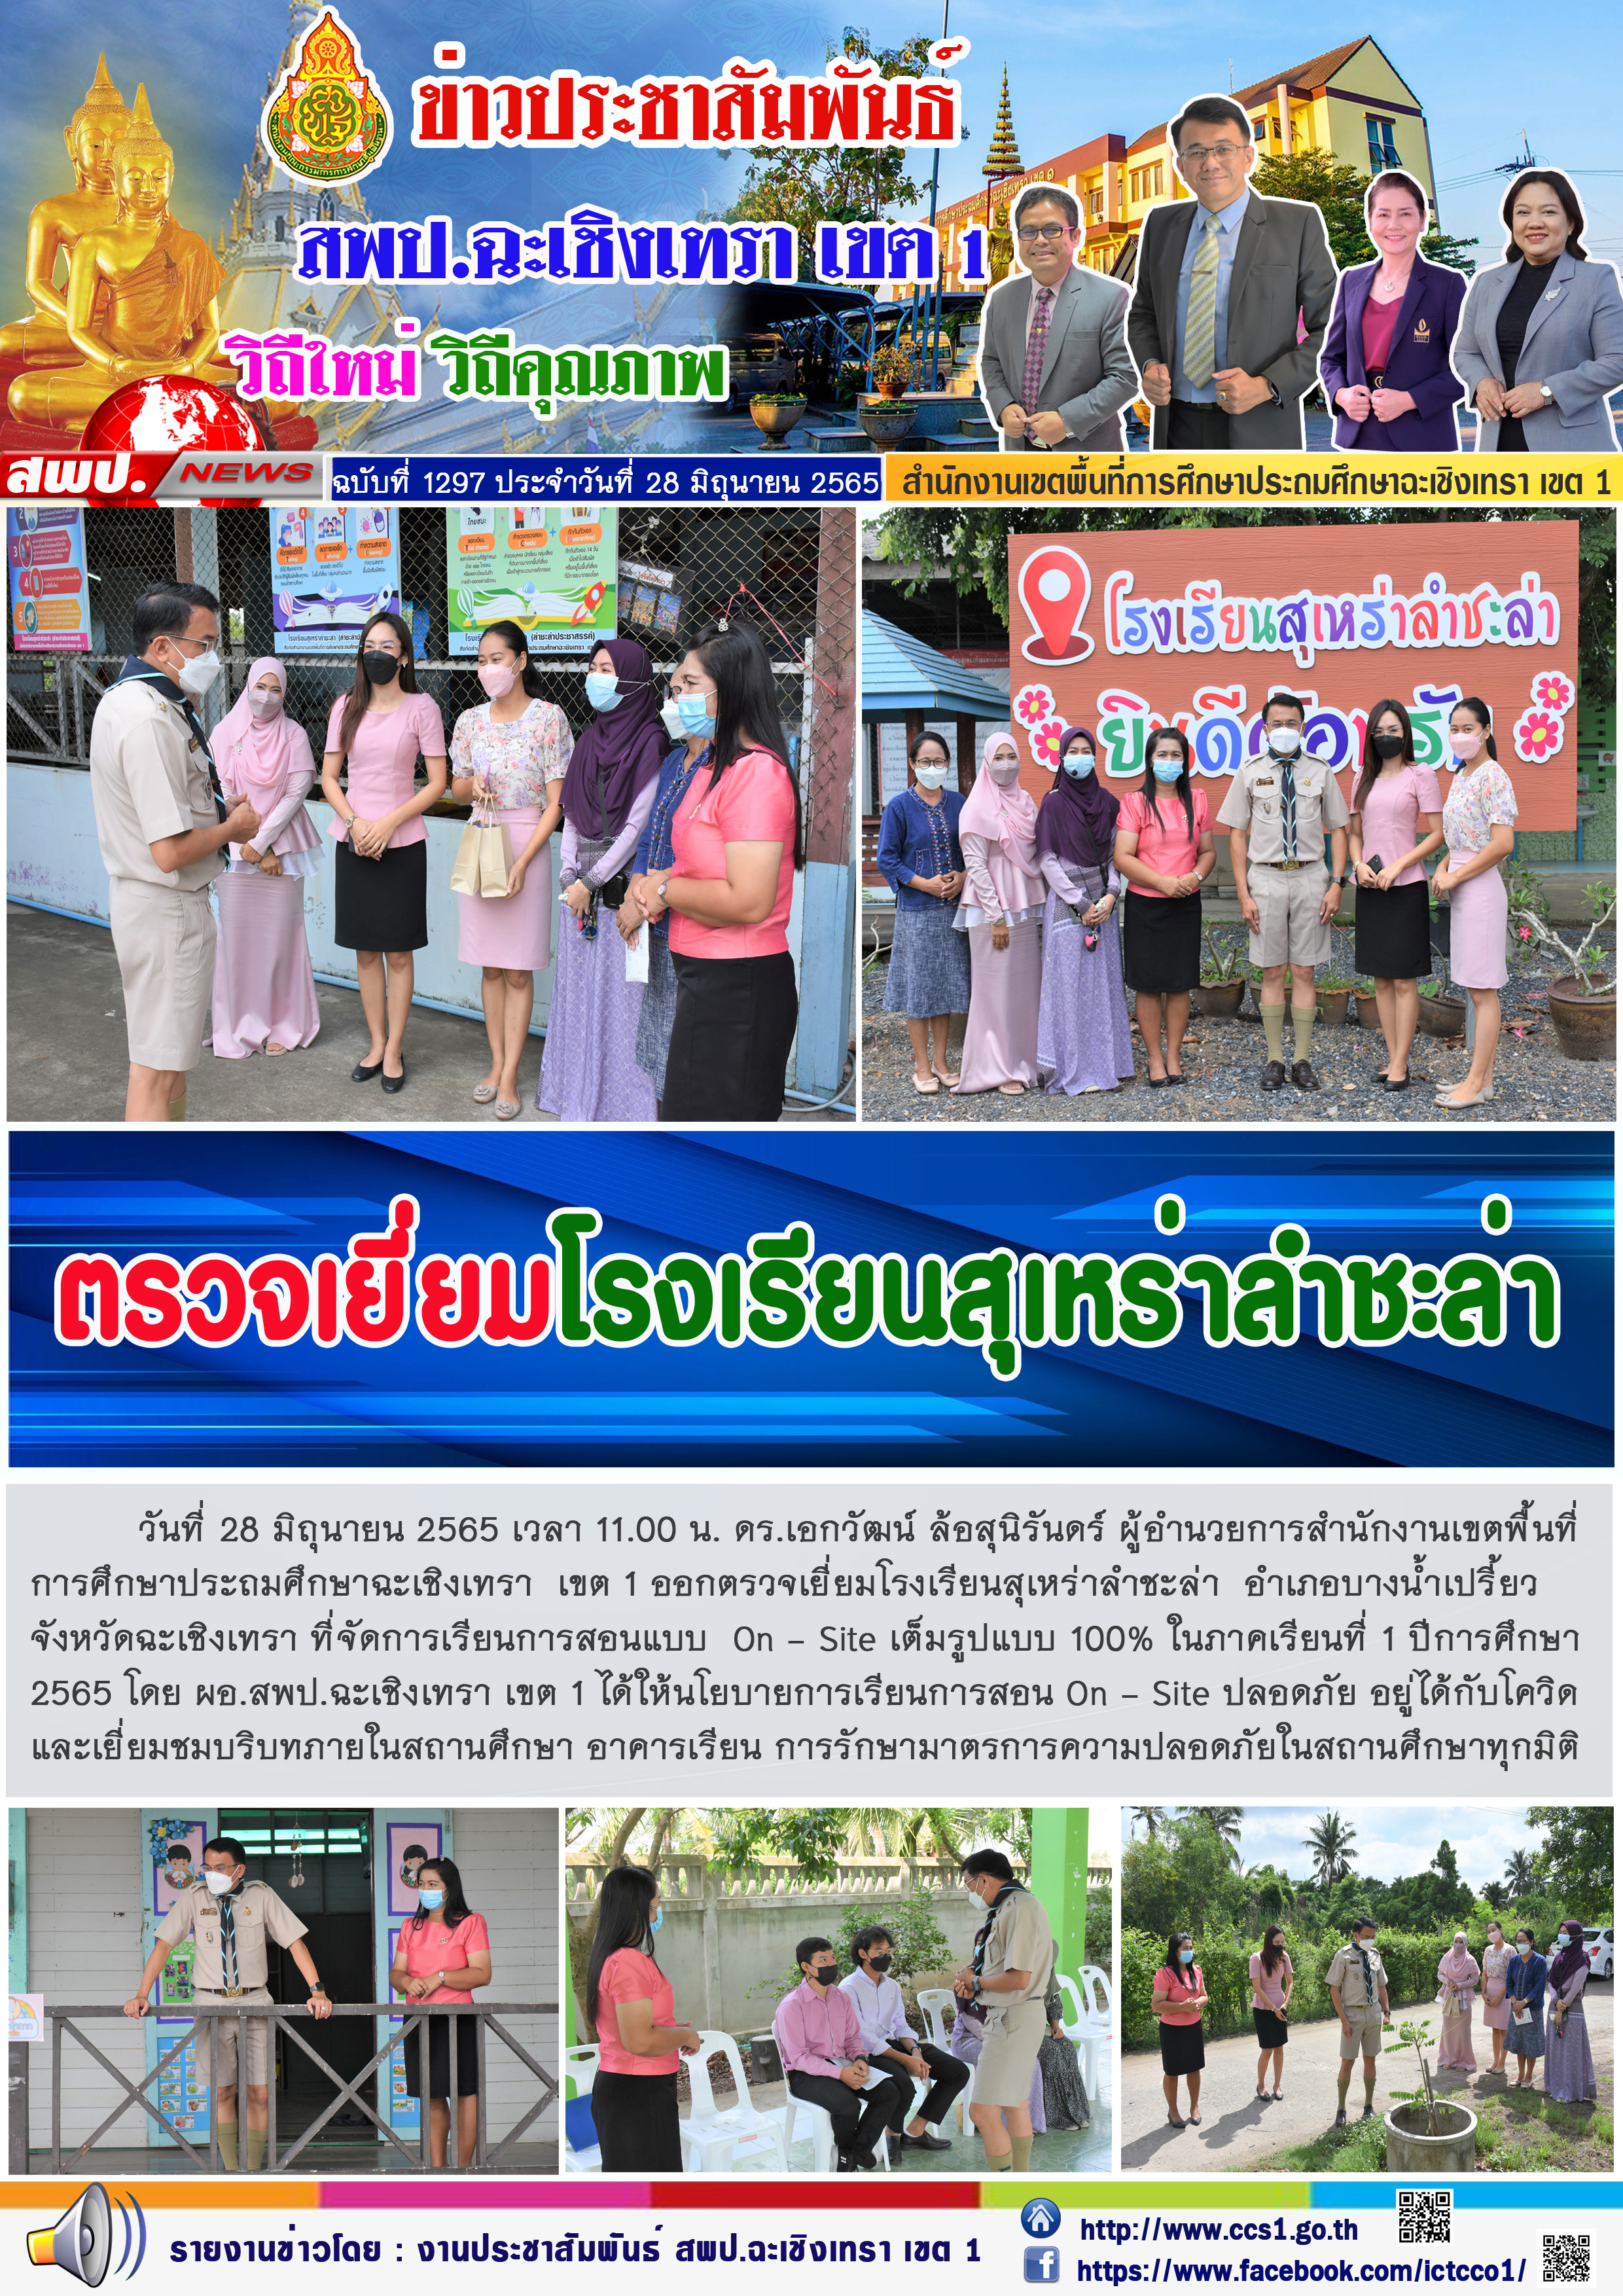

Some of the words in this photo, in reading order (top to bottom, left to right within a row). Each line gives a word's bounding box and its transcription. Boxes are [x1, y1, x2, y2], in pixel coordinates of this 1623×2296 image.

[19, 508, 24, 519] 2
[301, 509, 305, 517] 4
[13, 546, 18, 557] 3
[24, 578, 29, 588] 4
[18, 611, 23, 622] 5
[1111, 577, 1554, 660] โรงเรียนสุเหร่าลำชะล่า
